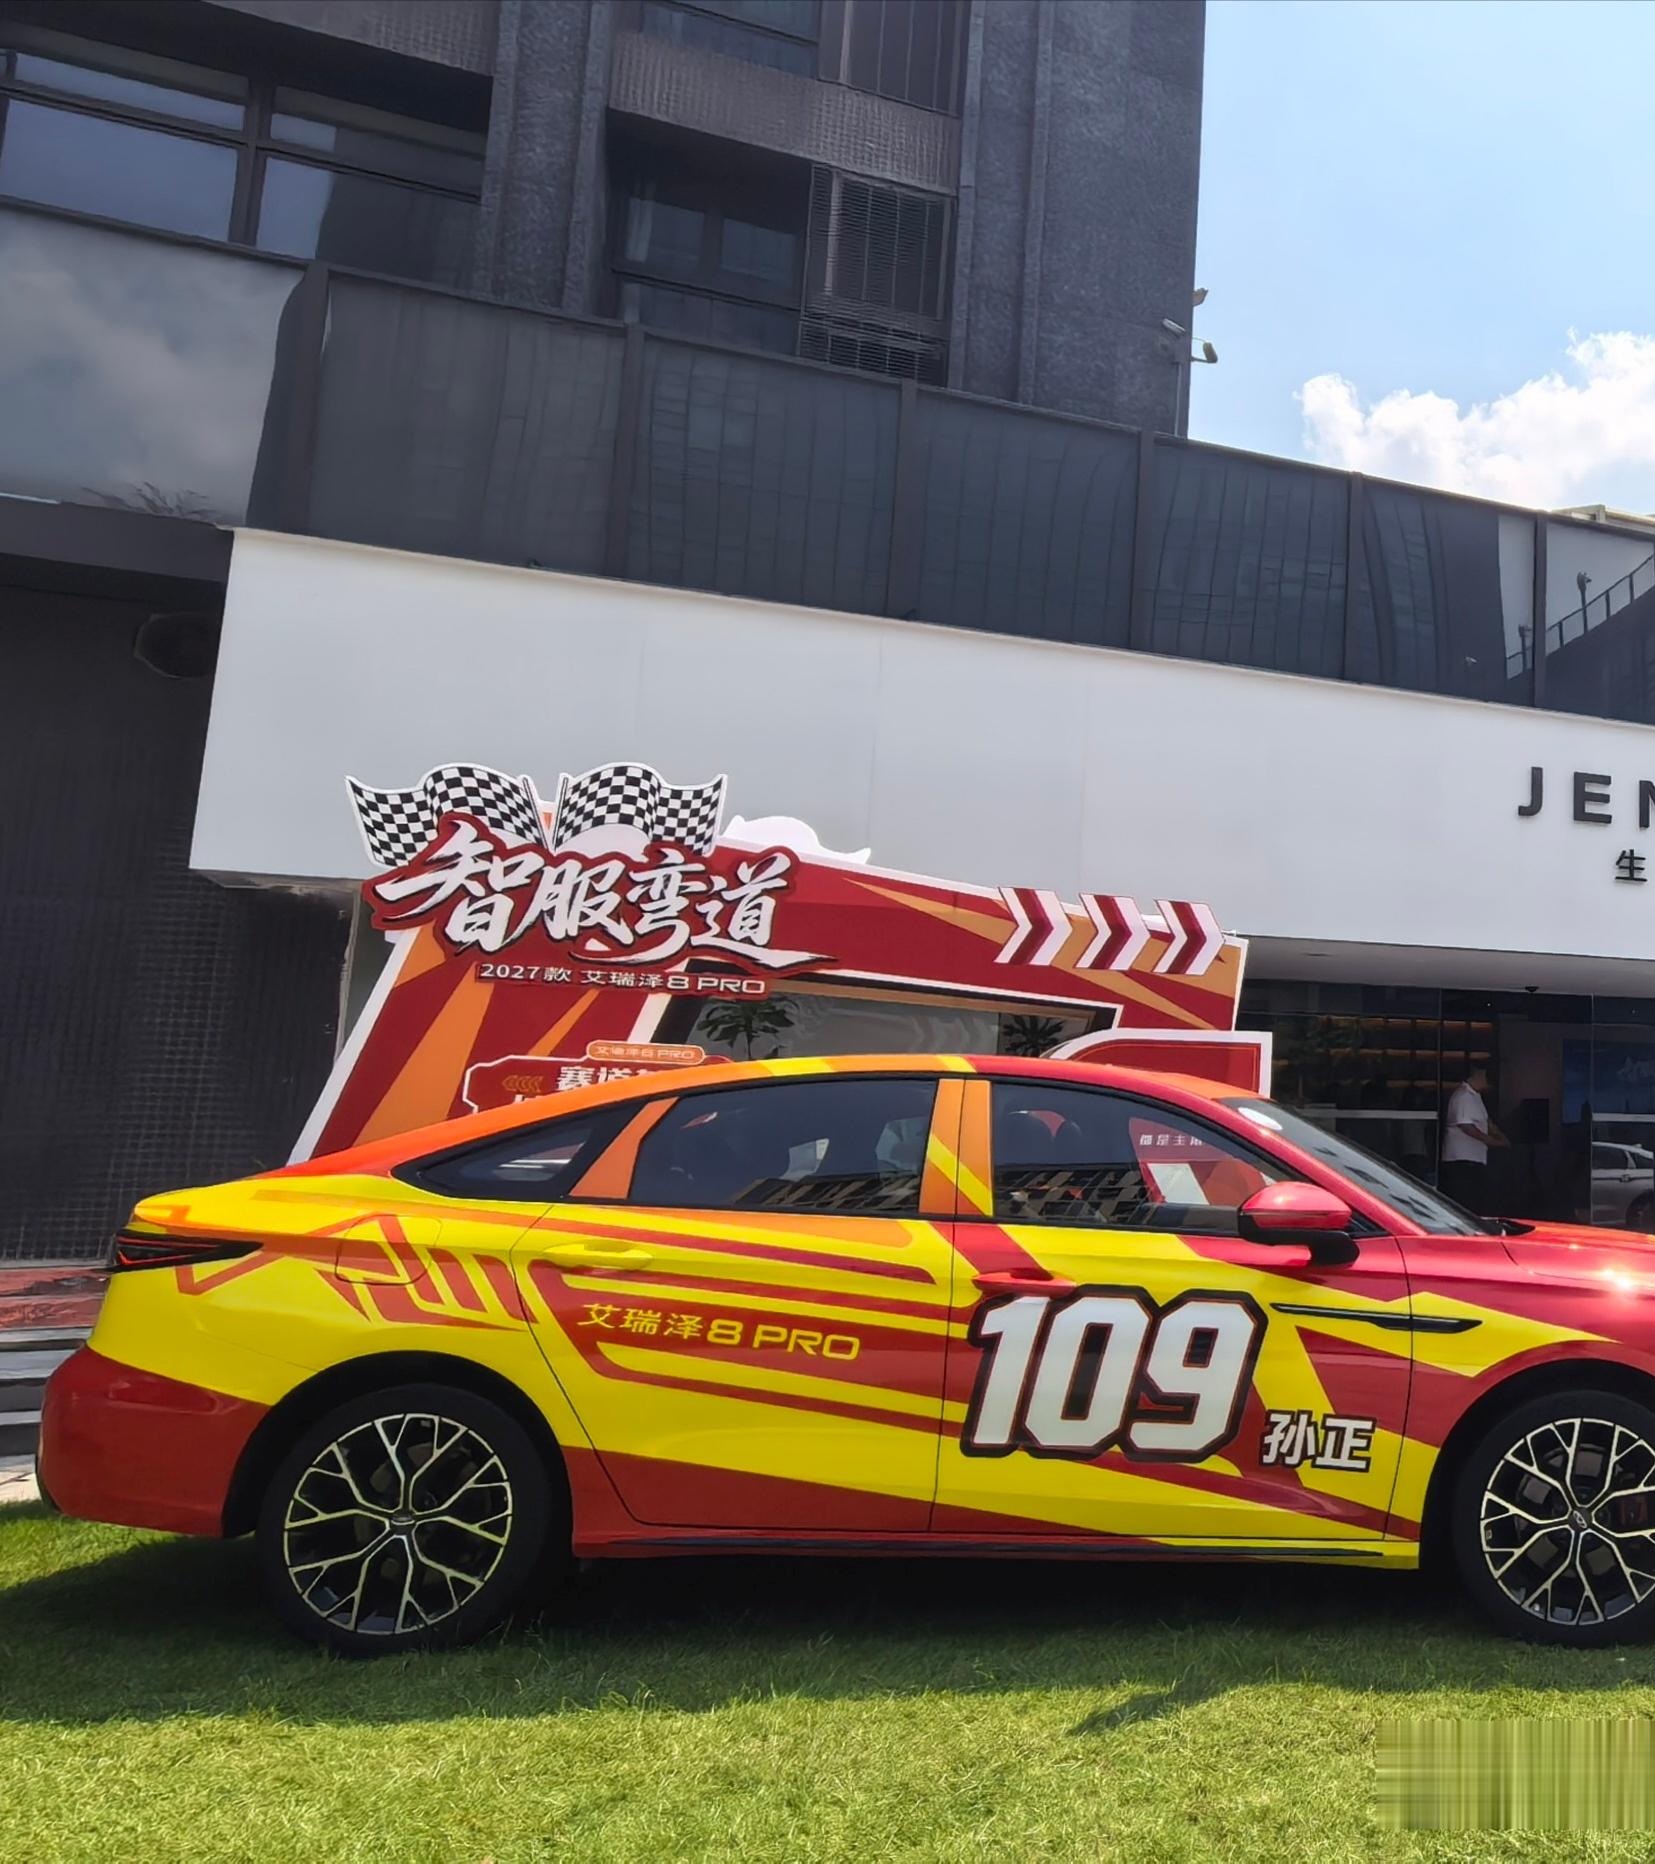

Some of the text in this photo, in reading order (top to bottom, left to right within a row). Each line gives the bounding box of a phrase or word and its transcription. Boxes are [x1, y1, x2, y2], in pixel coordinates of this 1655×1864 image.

[373, 822, 840, 972] 智服弯道
[480, 963, 766, 994] 2027款 艾瑞泽8 PRO
[657, 1048, 695, 1060] PRO
[576, 1301, 861, 1362] 艾瑞泽8 PRO
[969, 1292, 1258, 1456] 109
[1261, 1411, 1374, 1472] 孙正
